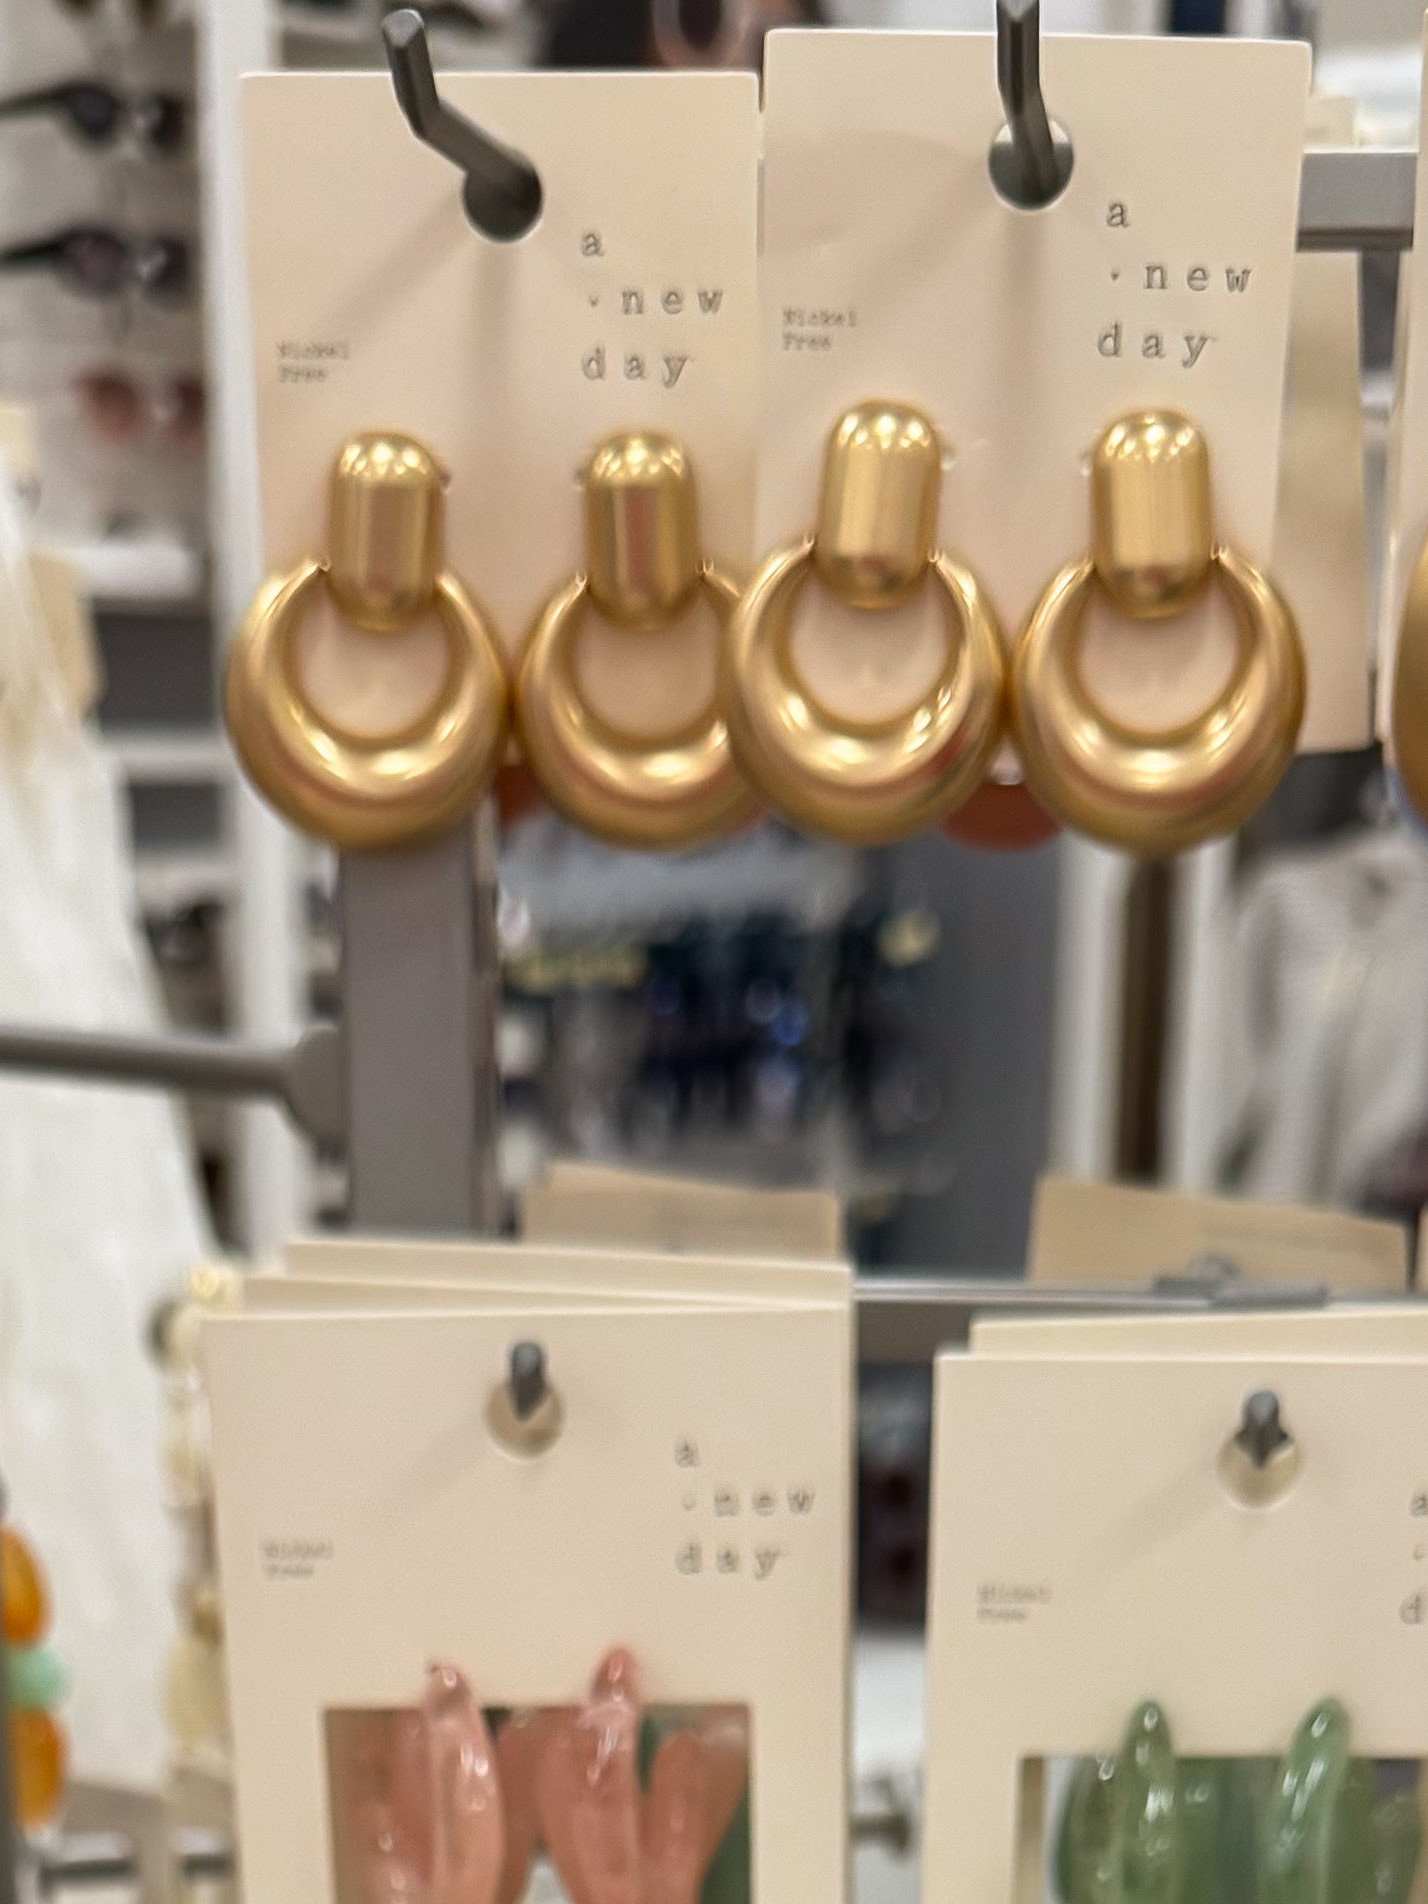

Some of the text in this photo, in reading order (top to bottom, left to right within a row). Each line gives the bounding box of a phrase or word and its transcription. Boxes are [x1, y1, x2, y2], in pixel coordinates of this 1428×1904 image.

[1106, 201, 1130, 229] a
[582, 231, 605, 258] a
[1097, 323, 1217, 368] day
[581, 347, 690, 389] day
